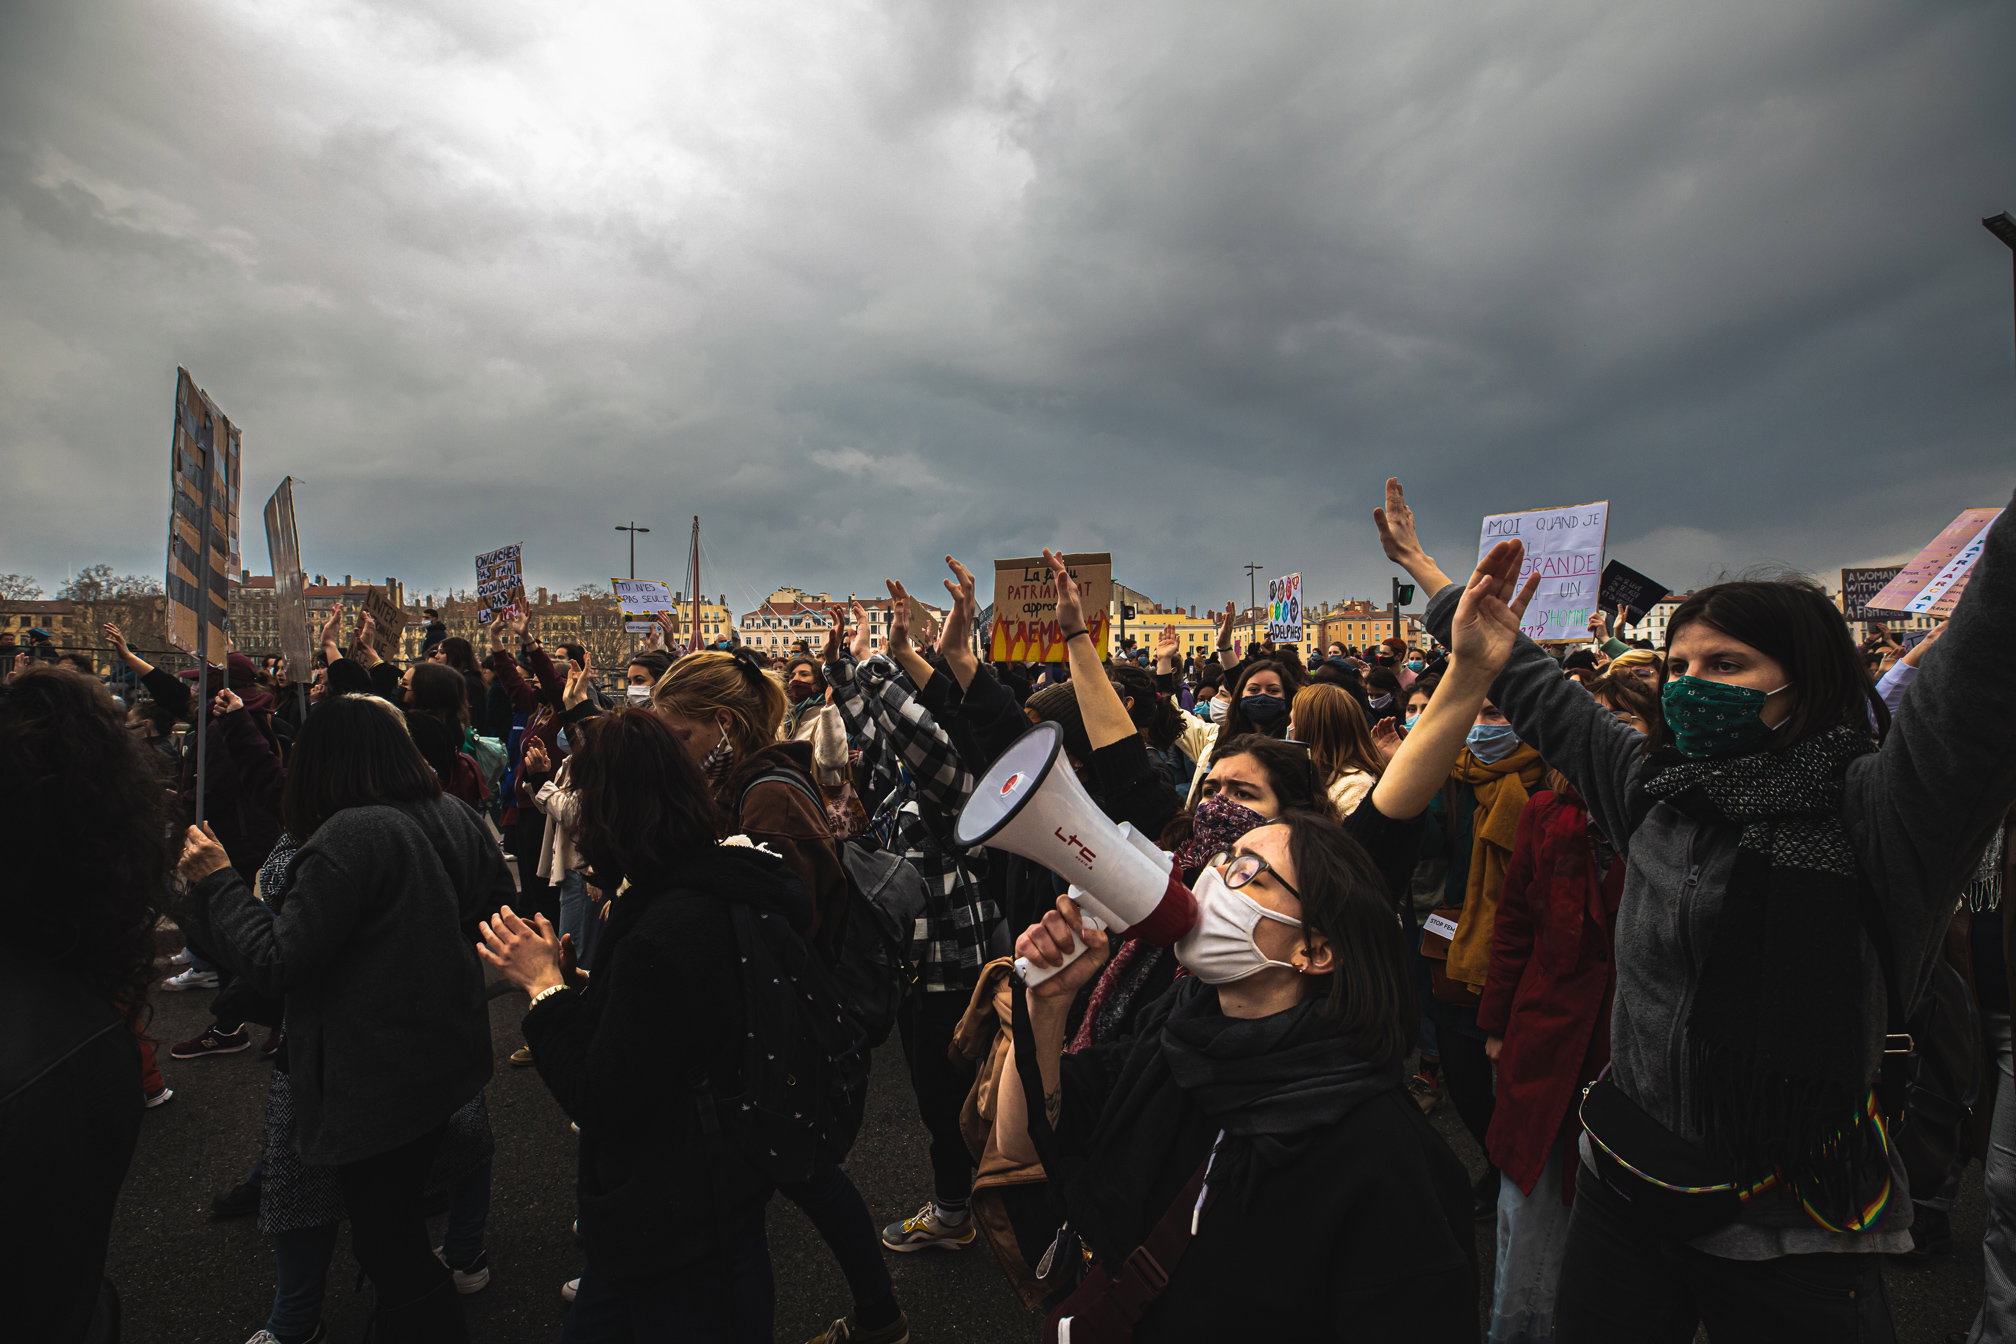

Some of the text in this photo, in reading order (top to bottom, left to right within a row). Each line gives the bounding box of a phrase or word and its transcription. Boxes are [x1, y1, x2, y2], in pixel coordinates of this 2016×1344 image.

[1488, 513, 1600, 535] MOI QUAND JE
[477, 555, 489, 568] ON
[1519, 554, 1597, 576] GRANDE
[478, 560, 516, 579] PAS TANT
[1023, 567, 1040, 582] La
[1848, 572, 1855, 582] A
[1857, 569, 1897, 581] WOMAN
[620, 583, 656, 592] TU N'ES
[1560, 581, 1581, 598] UN
[1846, 582, 1888, 592] WITHO
[492, 591, 507, 608] PAS
[623, 595, 670, 603] PAS SEULE
[1847, 593, 1874, 605] MAN
[479, 610, 491, 624] LA
[1538, 608, 1591, 627] D'HOMME
[1846, 606, 1854, 618] A
[1857, 605, 1879, 619] FISH
[1269, 621, 1301, 641] ADELPHES
[1430, 918, 1443, 926] STOP
